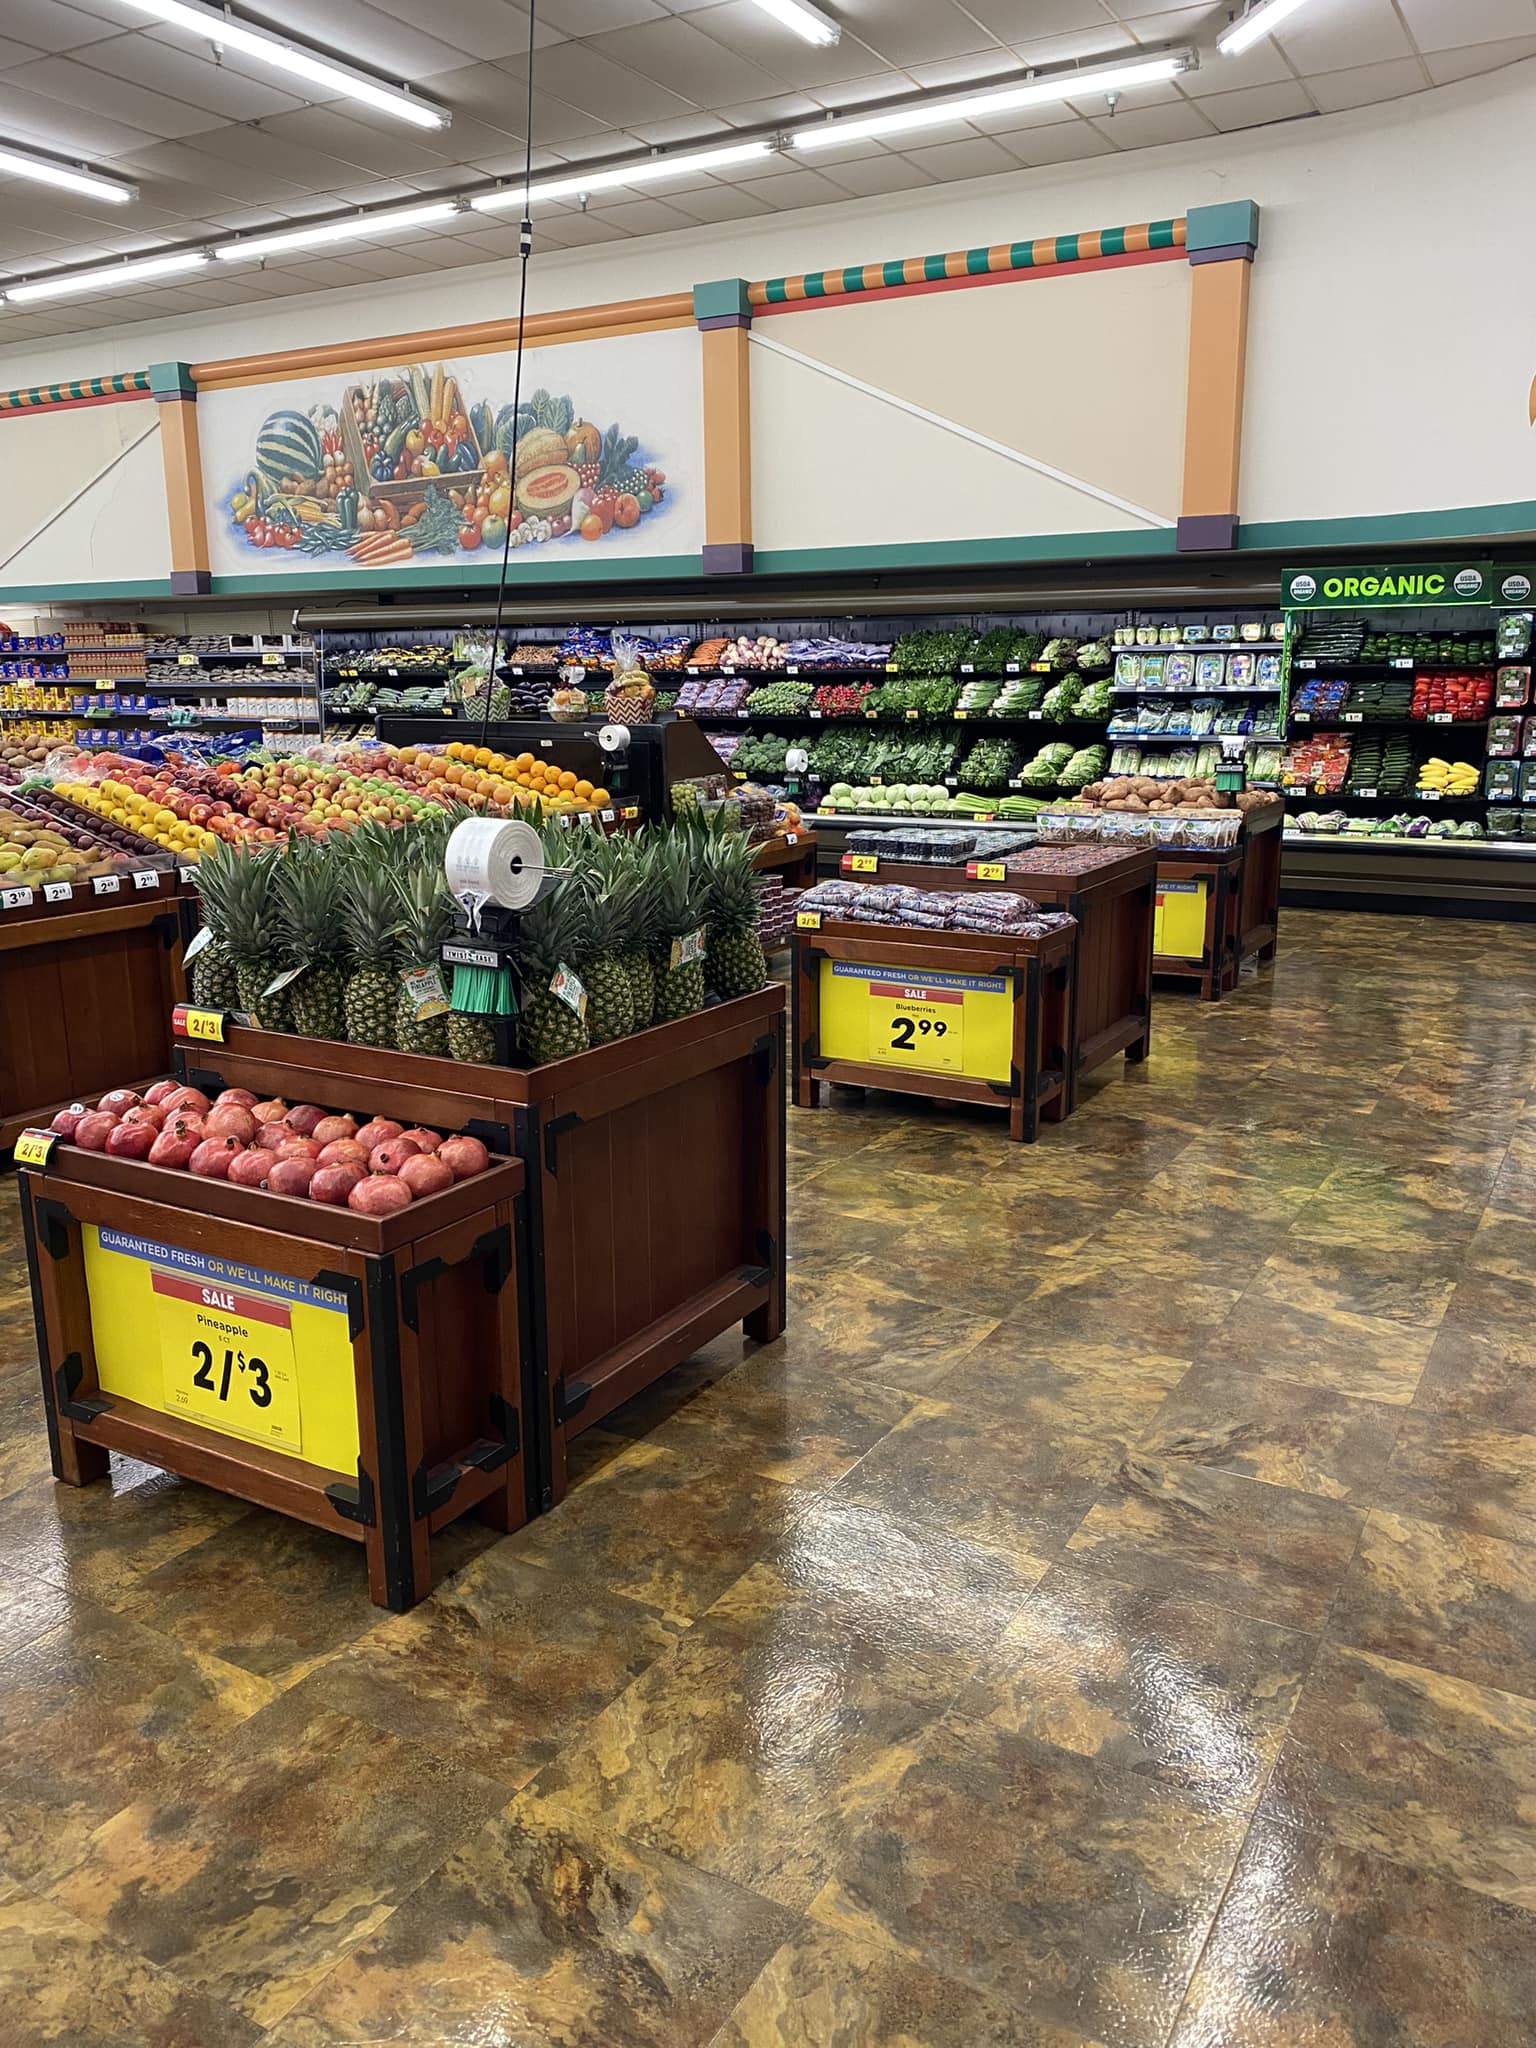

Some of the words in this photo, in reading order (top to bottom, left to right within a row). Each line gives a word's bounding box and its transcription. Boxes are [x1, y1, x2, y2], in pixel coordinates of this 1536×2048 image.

[1323, 574, 1445, 598] ORGANIC
[833, 965, 881, 977] GUARANTEED
[883, 970, 906, 979] FRESH
[921, 975, 944, 984] WE'LL
[945, 978, 967, 986] MAKE
[904, 988, 927, 1000] SALE
[896, 1003, 936, 1014] Blueberries
[101, 1231, 168, 1258] GUARANTEED
[171, 1249, 205, 1269] FRESH
[207, 1259, 224, 1273] OR
[227, 1265, 261, 1283] WE'LL
[263, 1274, 296, 1293] MAKE
[299, 1283, 308, 1296] IT
[202, 1288, 236, 1311] SALE
[197, 1313, 249, 1338] Pineapple
